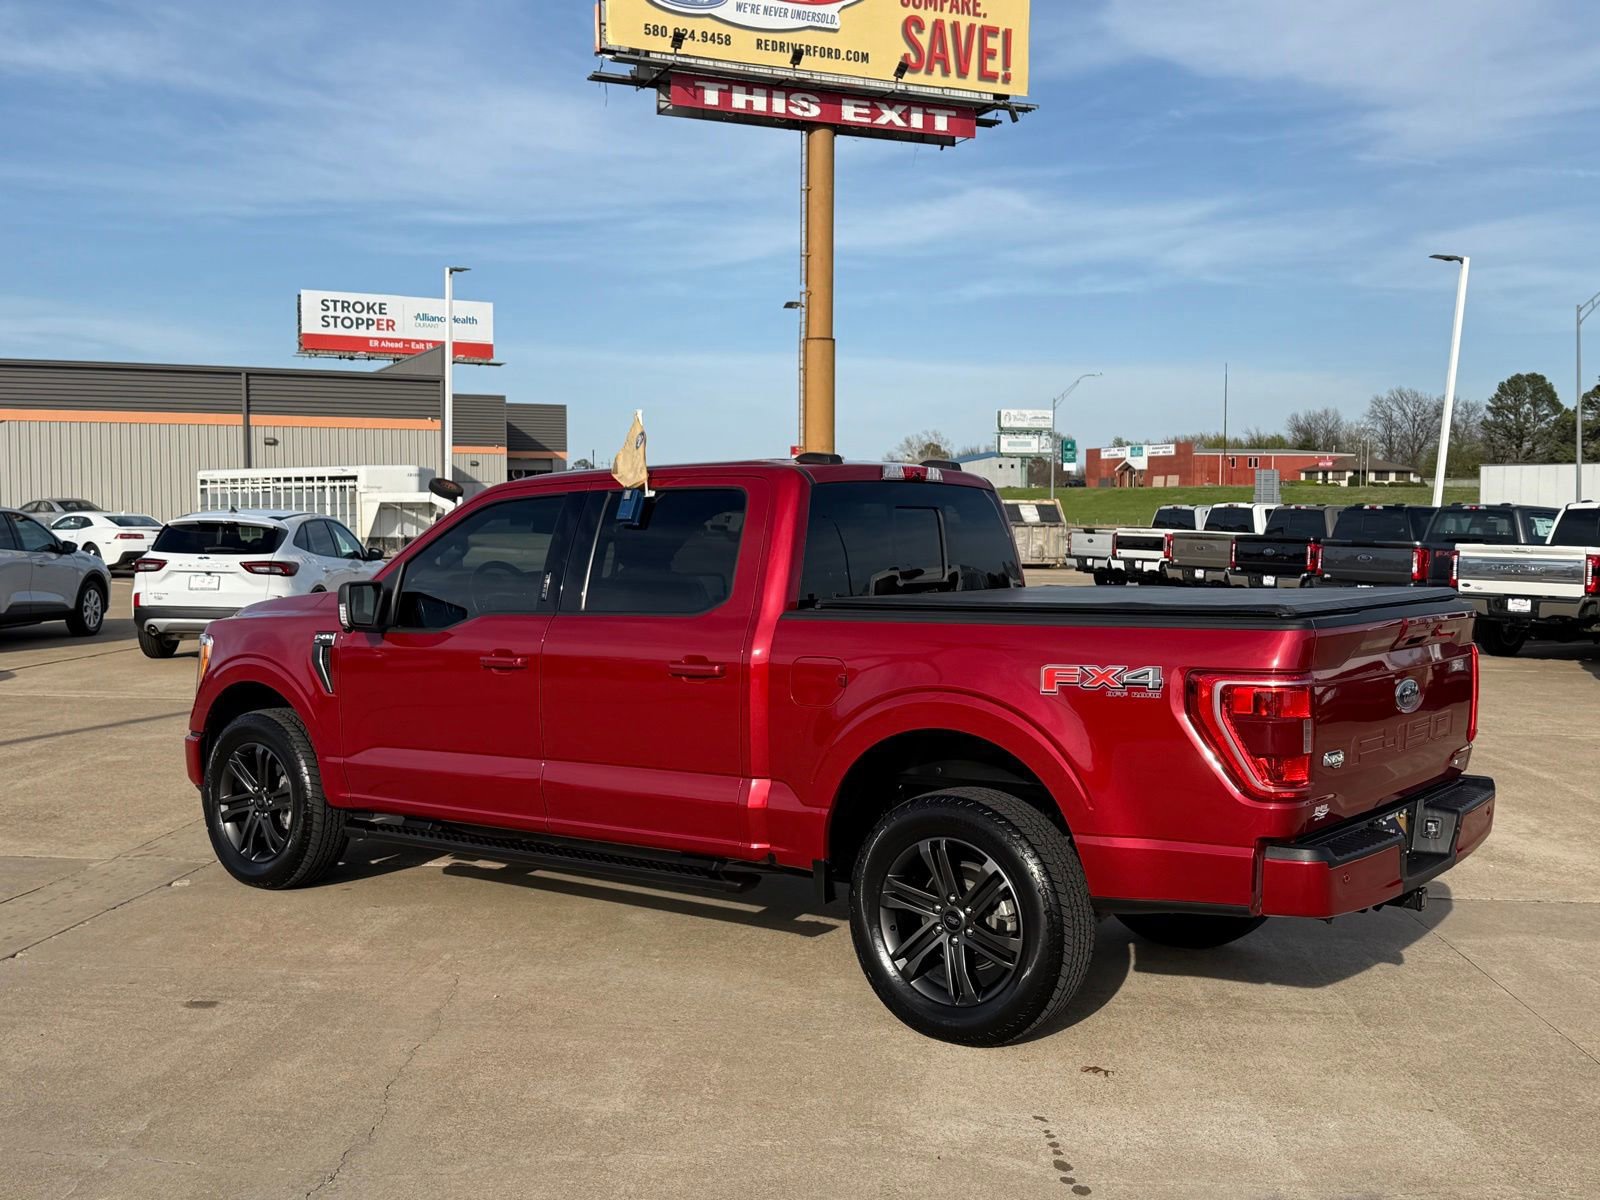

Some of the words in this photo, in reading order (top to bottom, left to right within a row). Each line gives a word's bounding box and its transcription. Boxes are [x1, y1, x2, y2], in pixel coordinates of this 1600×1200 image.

[735, 1, 762, 15] WE'RE
[762, 5, 789, 19] NEVER
[790, 9, 838, 26] UNDERSOLD.
[902, 14, 1013, 83] SAVE!
[694, 81, 822, 118] THIS
[841, 98, 957, 132] EXIT
[320, 298, 388, 316] STROKE
[320, 314, 396, 332] STOPPER
[380, 340, 404, 349] Ahead
[411, 341, 425, 350] Exit
[1040, 664, 1164, 695] FX4
